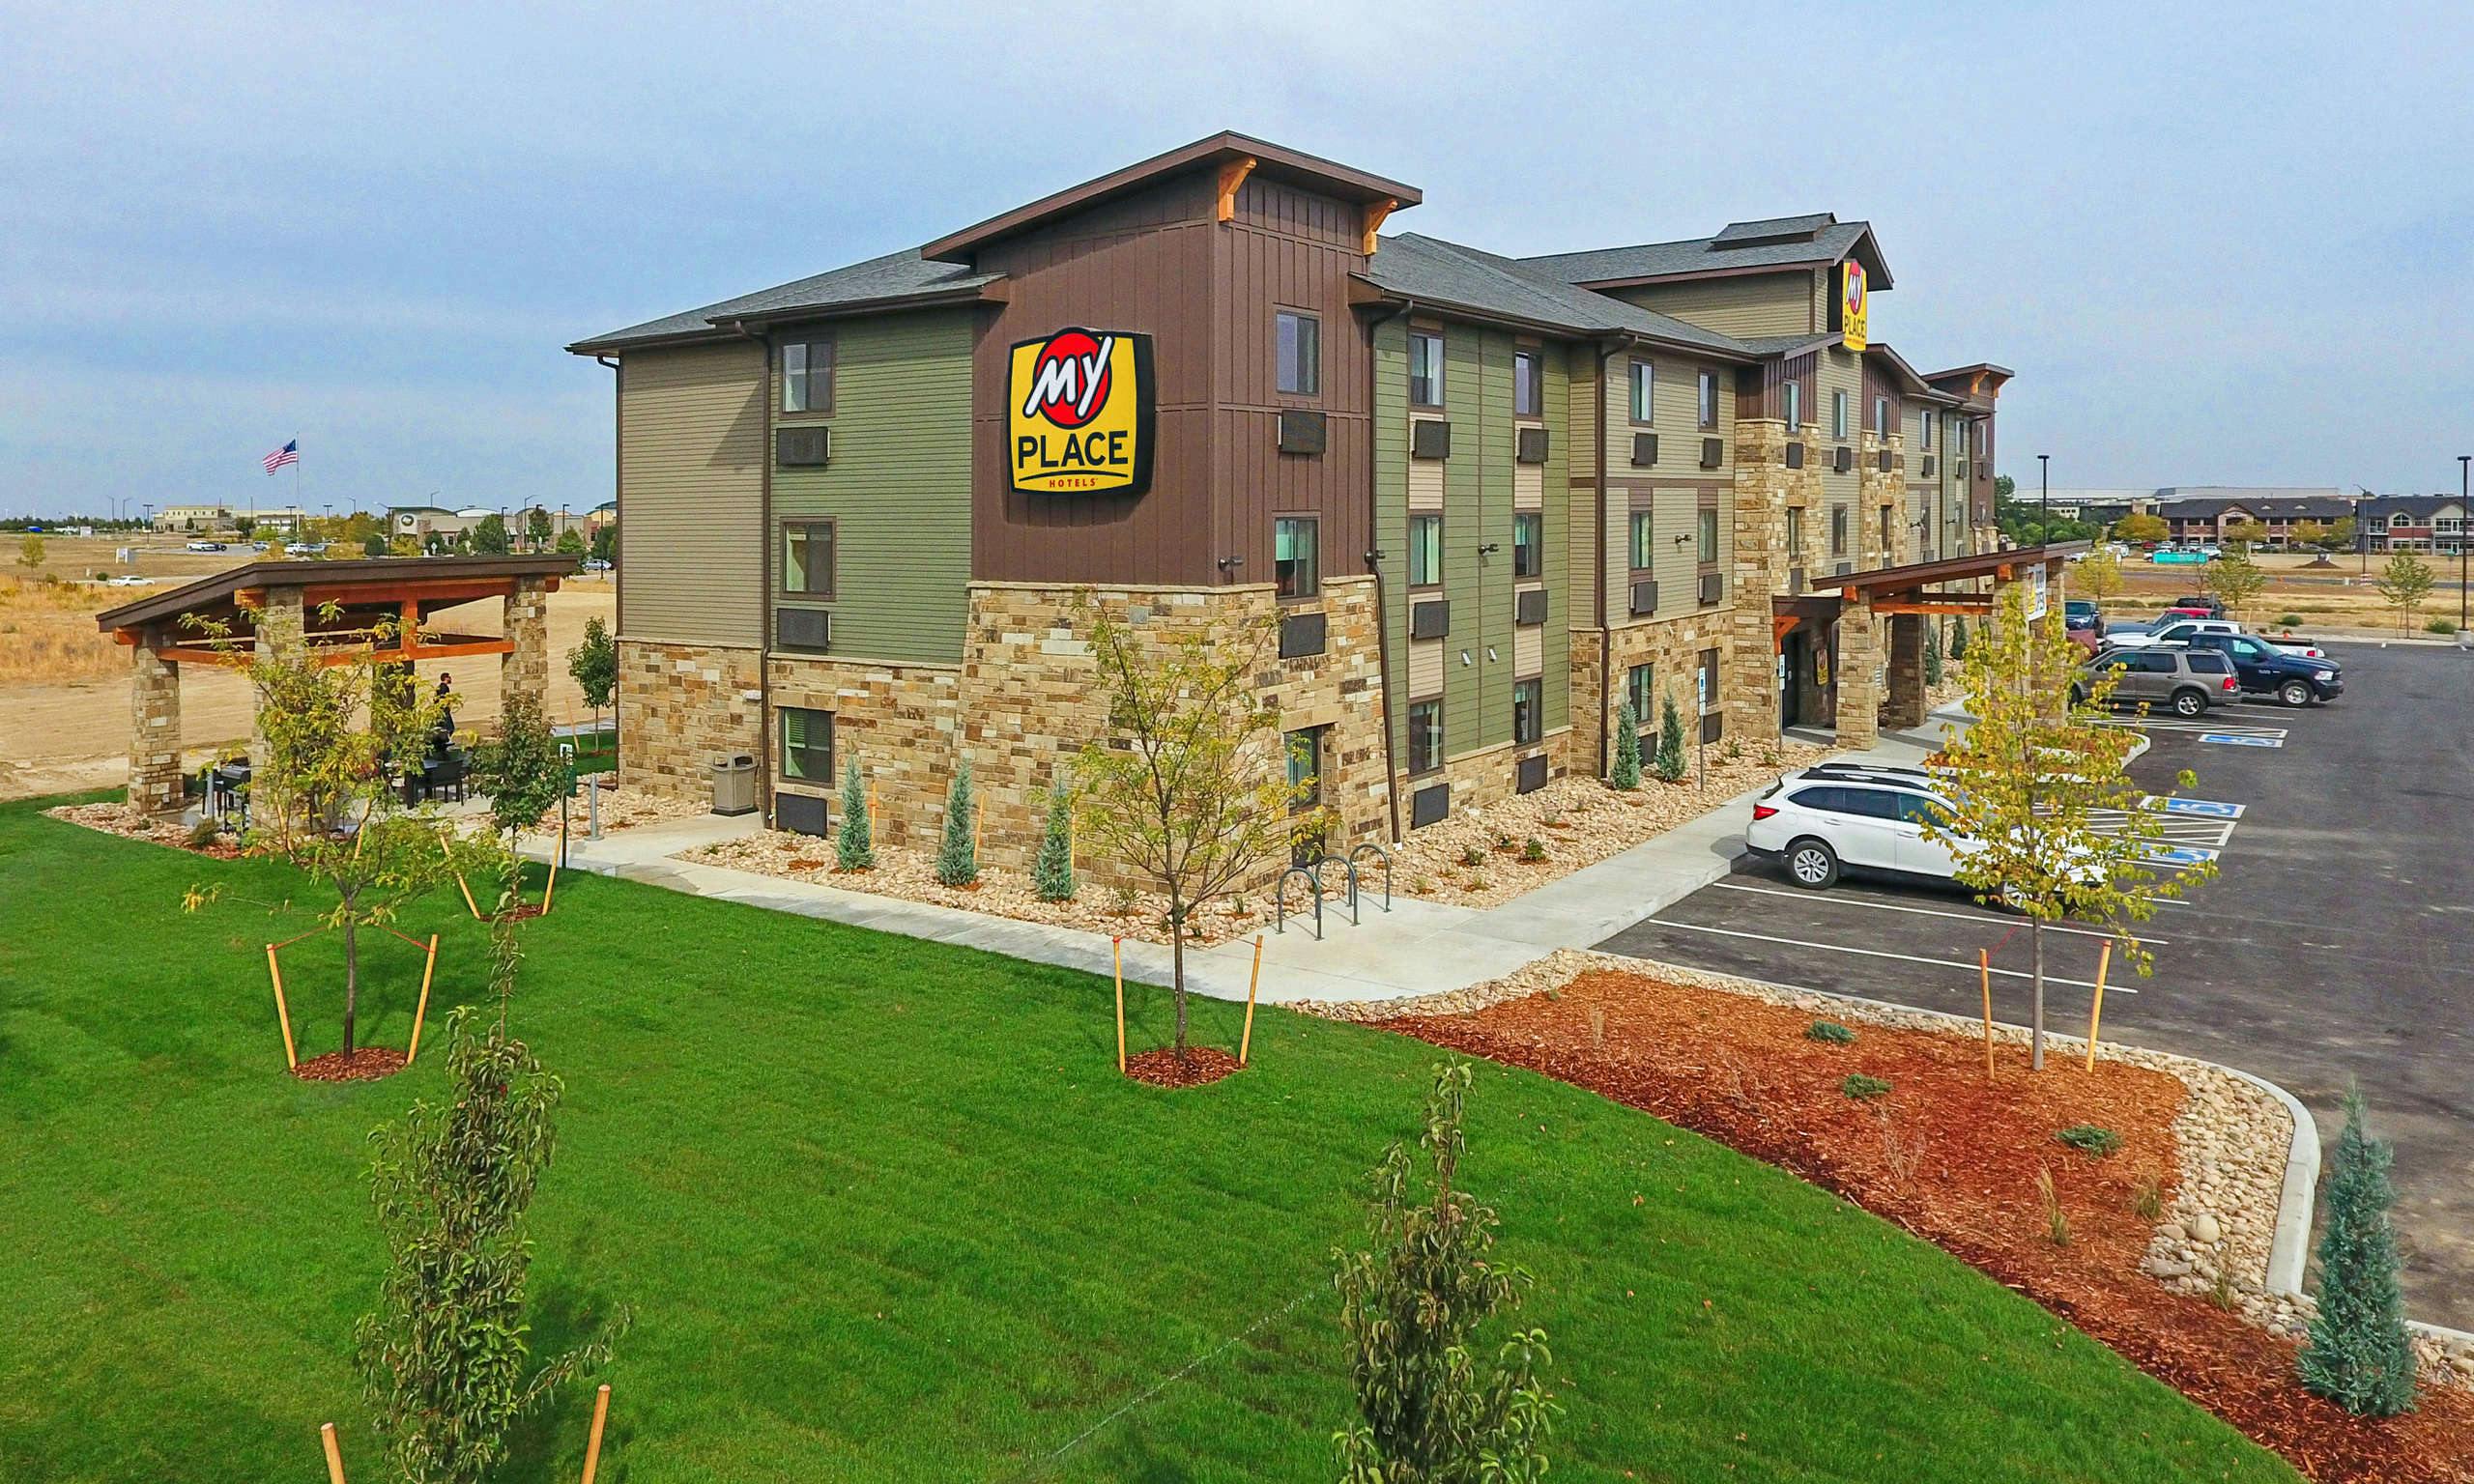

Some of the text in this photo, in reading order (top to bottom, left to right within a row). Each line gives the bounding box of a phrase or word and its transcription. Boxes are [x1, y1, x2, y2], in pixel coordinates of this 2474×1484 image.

[1845, 315, 1865, 338] PLACE
[1018, 430, 1129, 469] PLACE
[1049, 477, 1096, 488] HOTELS
